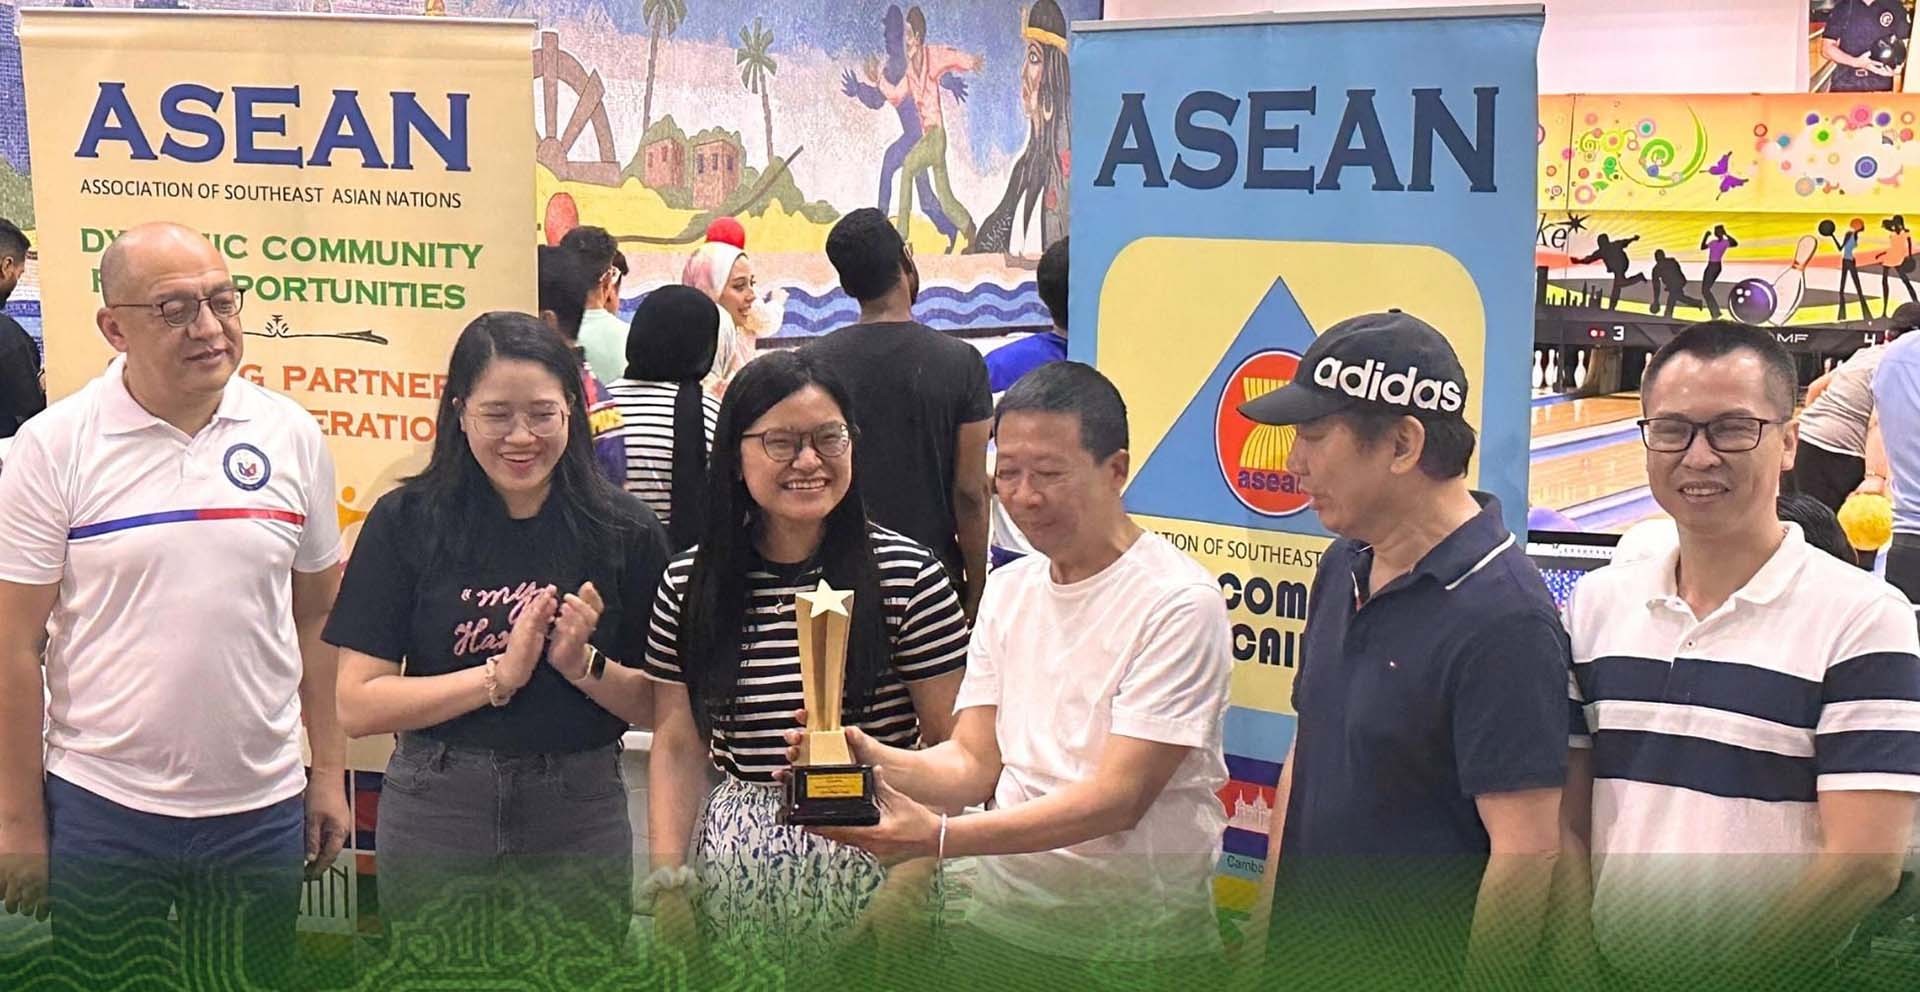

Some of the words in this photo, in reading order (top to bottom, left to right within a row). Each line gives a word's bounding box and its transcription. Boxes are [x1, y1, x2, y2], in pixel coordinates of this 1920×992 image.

[75, 82, 471, 172] ASEAN
[1094, 86, 1499, 194] ASEAN
[80, 178, 193, 198] ASSOCIATION
[198, 183, 220, 199] OF
[224, 184, 324, 204] SOUTHEAST
[332, 188, 381, 206] ASIAN
[386, 191, 462, 209] NATIONS
[262, 235, 484, 269] COMMUNITY
[232, 274, 466, 310] PORTUNITIES
[1613, 325, 1625, 341] 3
[1769, 331, 1809, 344] MF
[1864, 332, 1876, 346] 4
[1313, 356, 1462, 412] adidas
[307, 409, 436, 442] ERATIO
[1238, 470, 1300, 494] asea
[1203, 537, 1224, 555] OF
[1217, 572, 1308, 620] COM
[1232, 623, 1304, 668] CAI
[1227, 854, 1265, 874] Cambo
